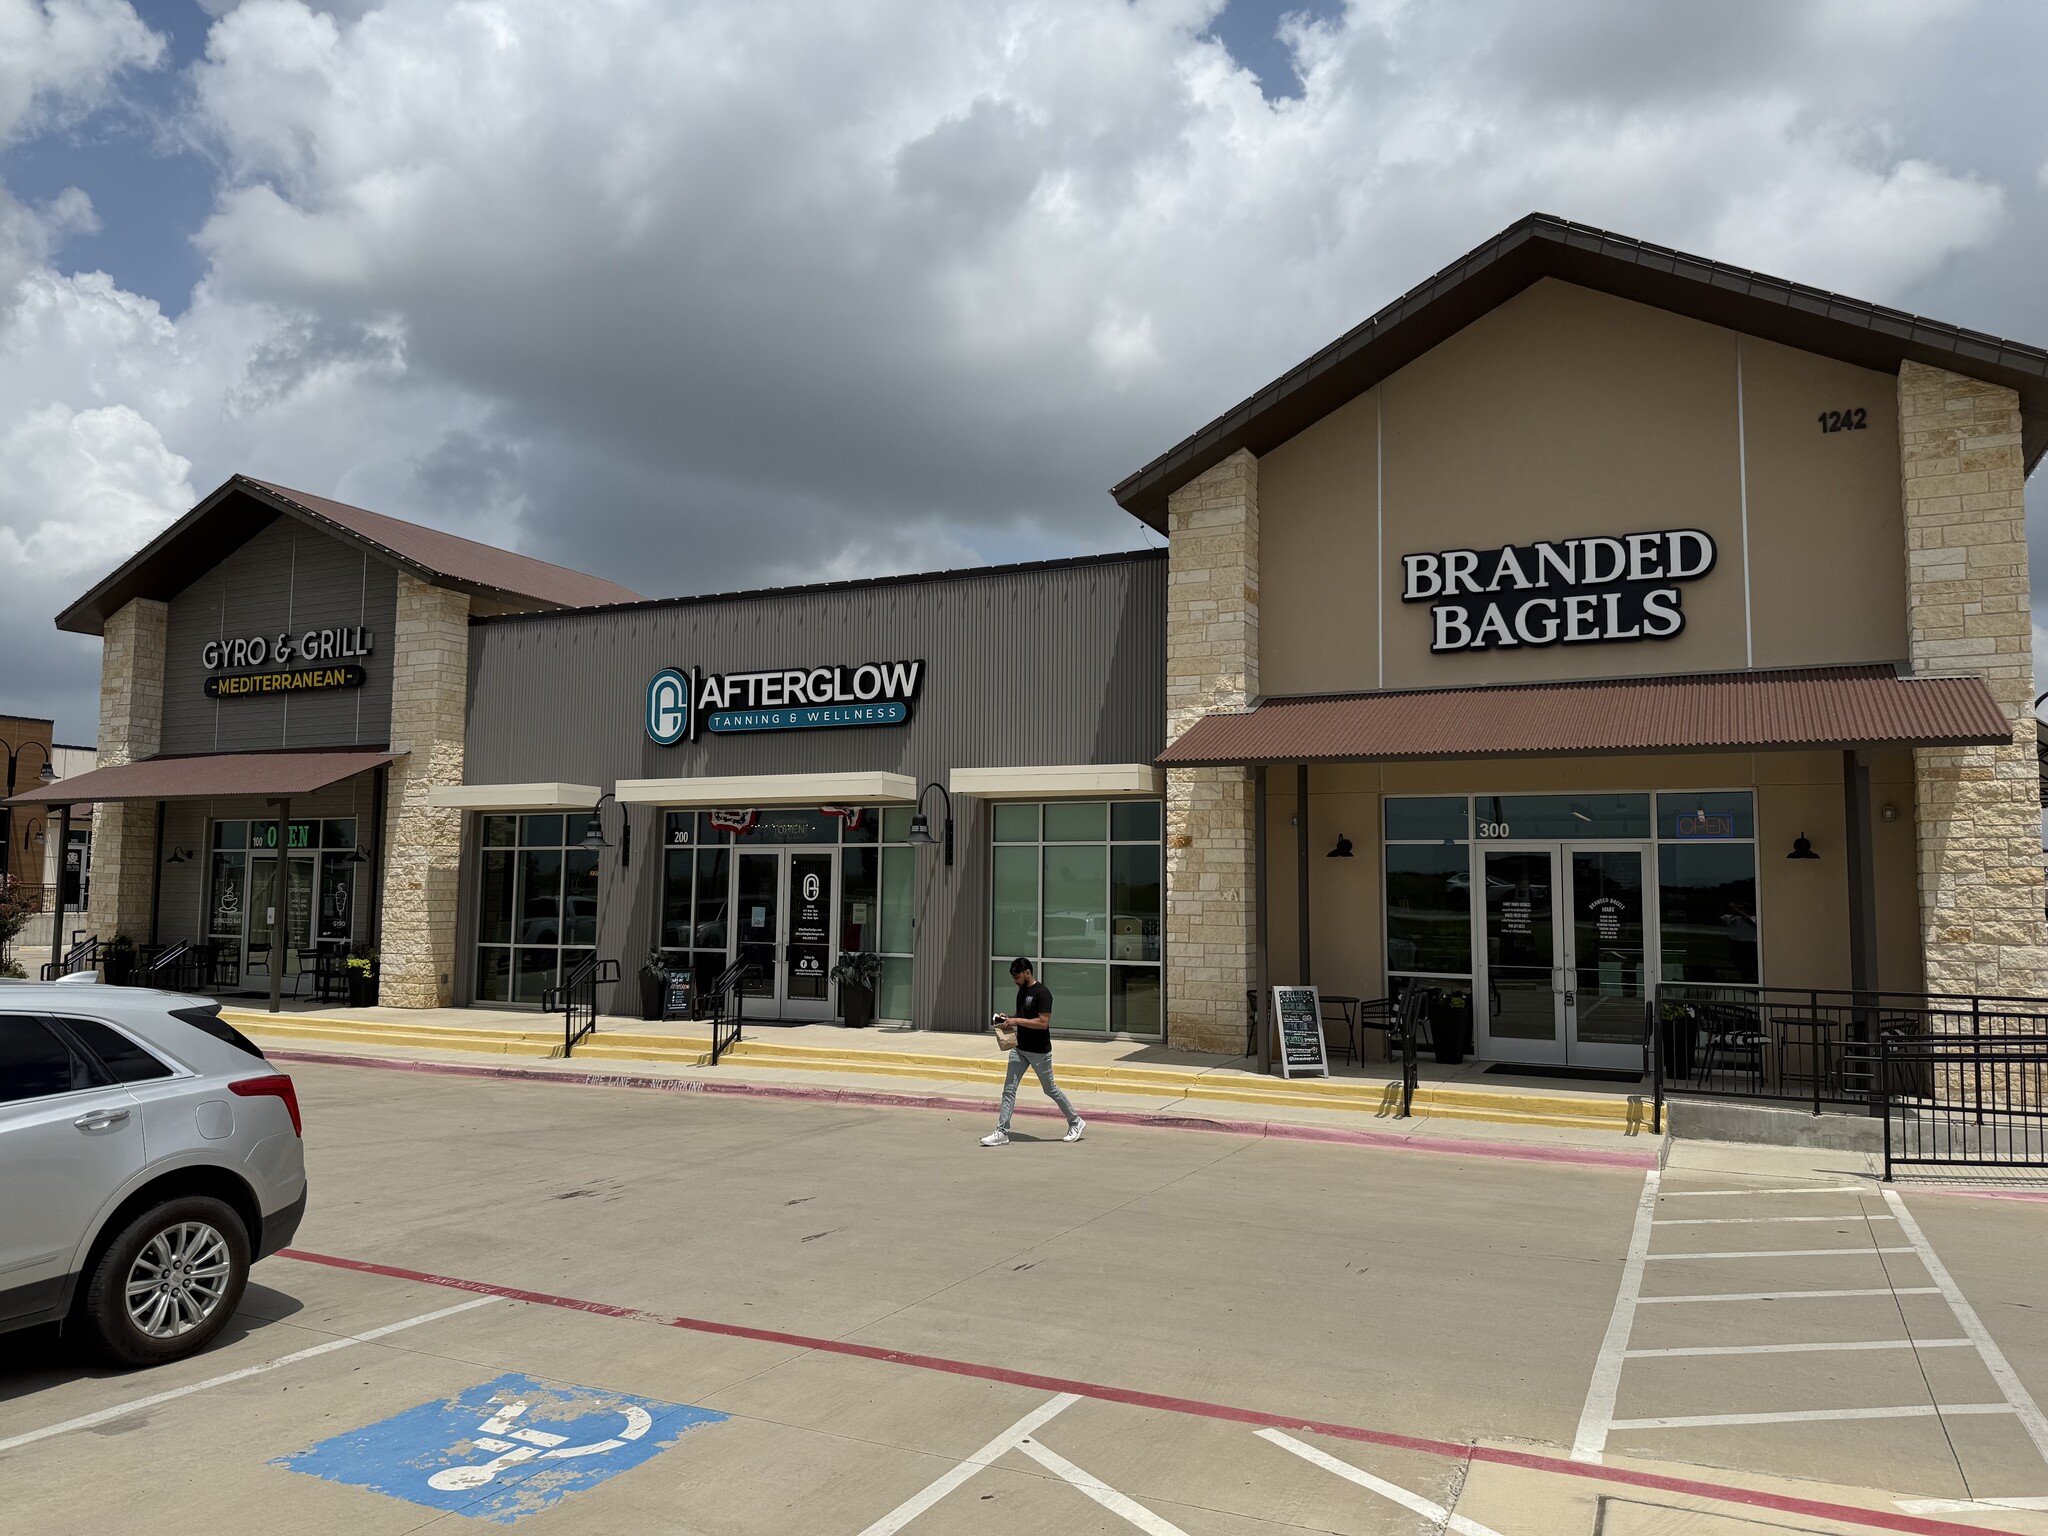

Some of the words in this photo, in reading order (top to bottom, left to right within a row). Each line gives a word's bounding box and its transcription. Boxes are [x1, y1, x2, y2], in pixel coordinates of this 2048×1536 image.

[1818, 408, 1867, 433] 1242
[1403, 530, 1713, 599] BRANDED
[1432, 589, 1681, 650] BAGELS
[202, 636, 267, 670] GYRO
[275, 633, 292, 663] &
[301, 626, 368, 661] GRILL
[698, 662, 919, 710] AFTERGLOW
[714, 711, 780, 727] TANNING
[789, 712, 797, 723] &
[807, 707, 896, 722] WELLNESS
[777, 825, 805, 835] OPEN
[1479, 823, 1509, 838] 300
[1679, 817, 1730, 835] OPEN
[253, 837, 263, 847] 100
[268, 826, 309, 847] OEN
[674, 831, 689, 843] 200
[585, 1074, 606, 1086] FIRE
[608, 1076, 631, 1088] LANE
[650, 1079, 664, 1089] NO
[666, 1080, 704, 1093] PARKING
